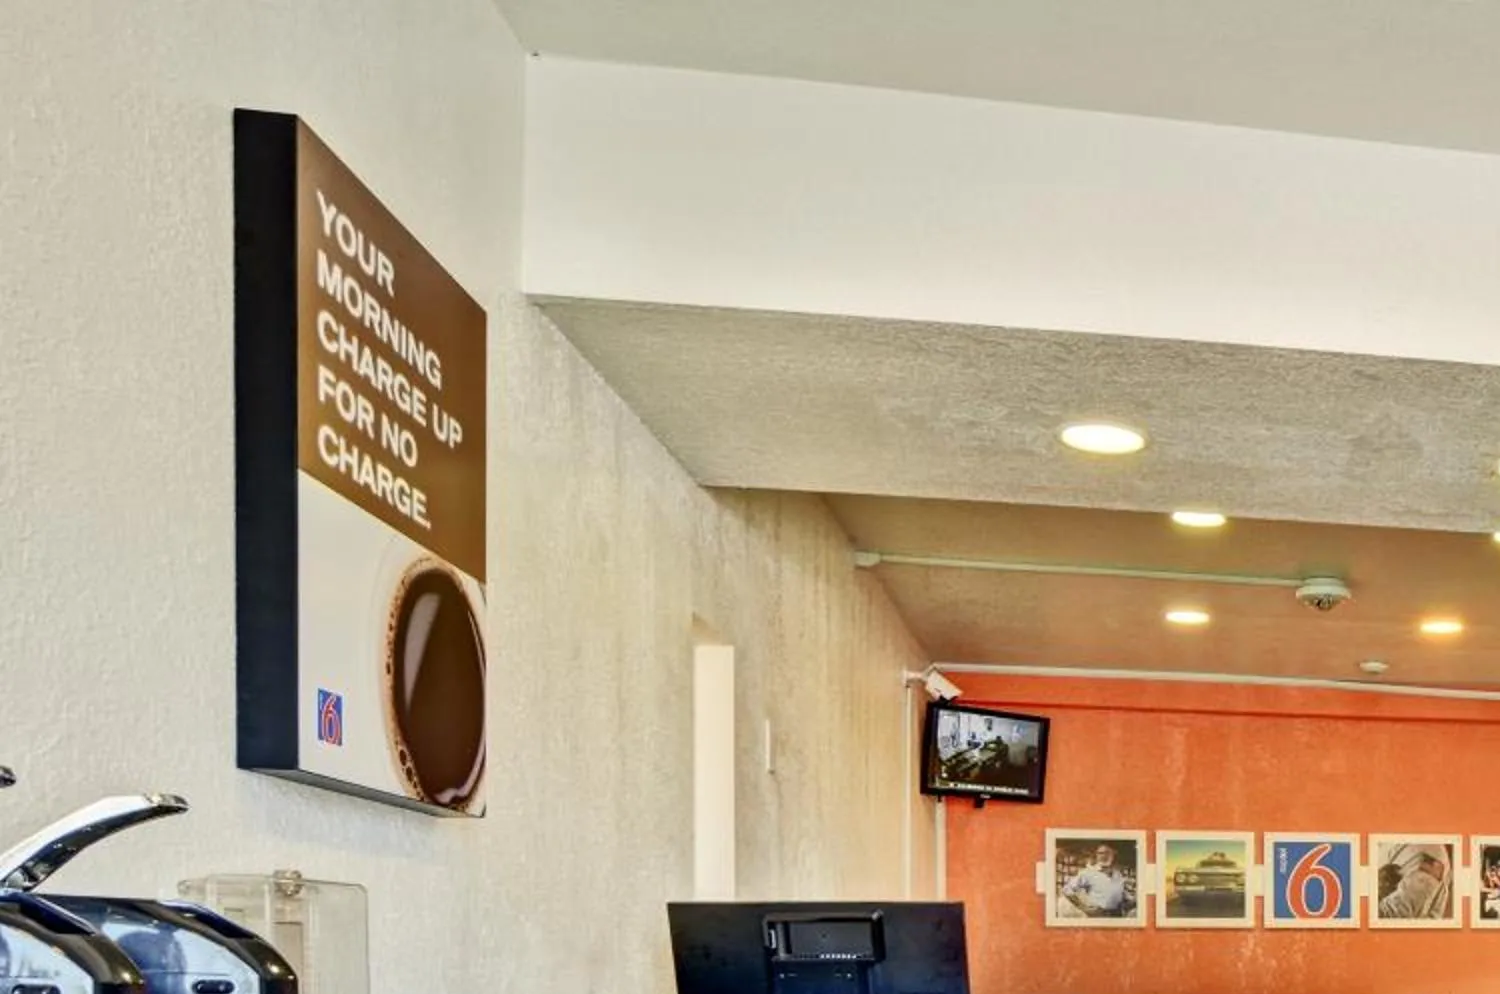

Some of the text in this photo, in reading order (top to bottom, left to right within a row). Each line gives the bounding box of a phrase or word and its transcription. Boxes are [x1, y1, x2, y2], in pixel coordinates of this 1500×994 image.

[316, 189, 395, 298] YOUR
[317, 249, 442, 391] MORNING
[317, 310, 463, 449] CHARGE UP
[319, 364, 419, 468] FOR NO
[318, 424, 432, 530] CHARGE.
[321, 694, 341, 745] 6
[1285, 843, 1343, 919] 6
